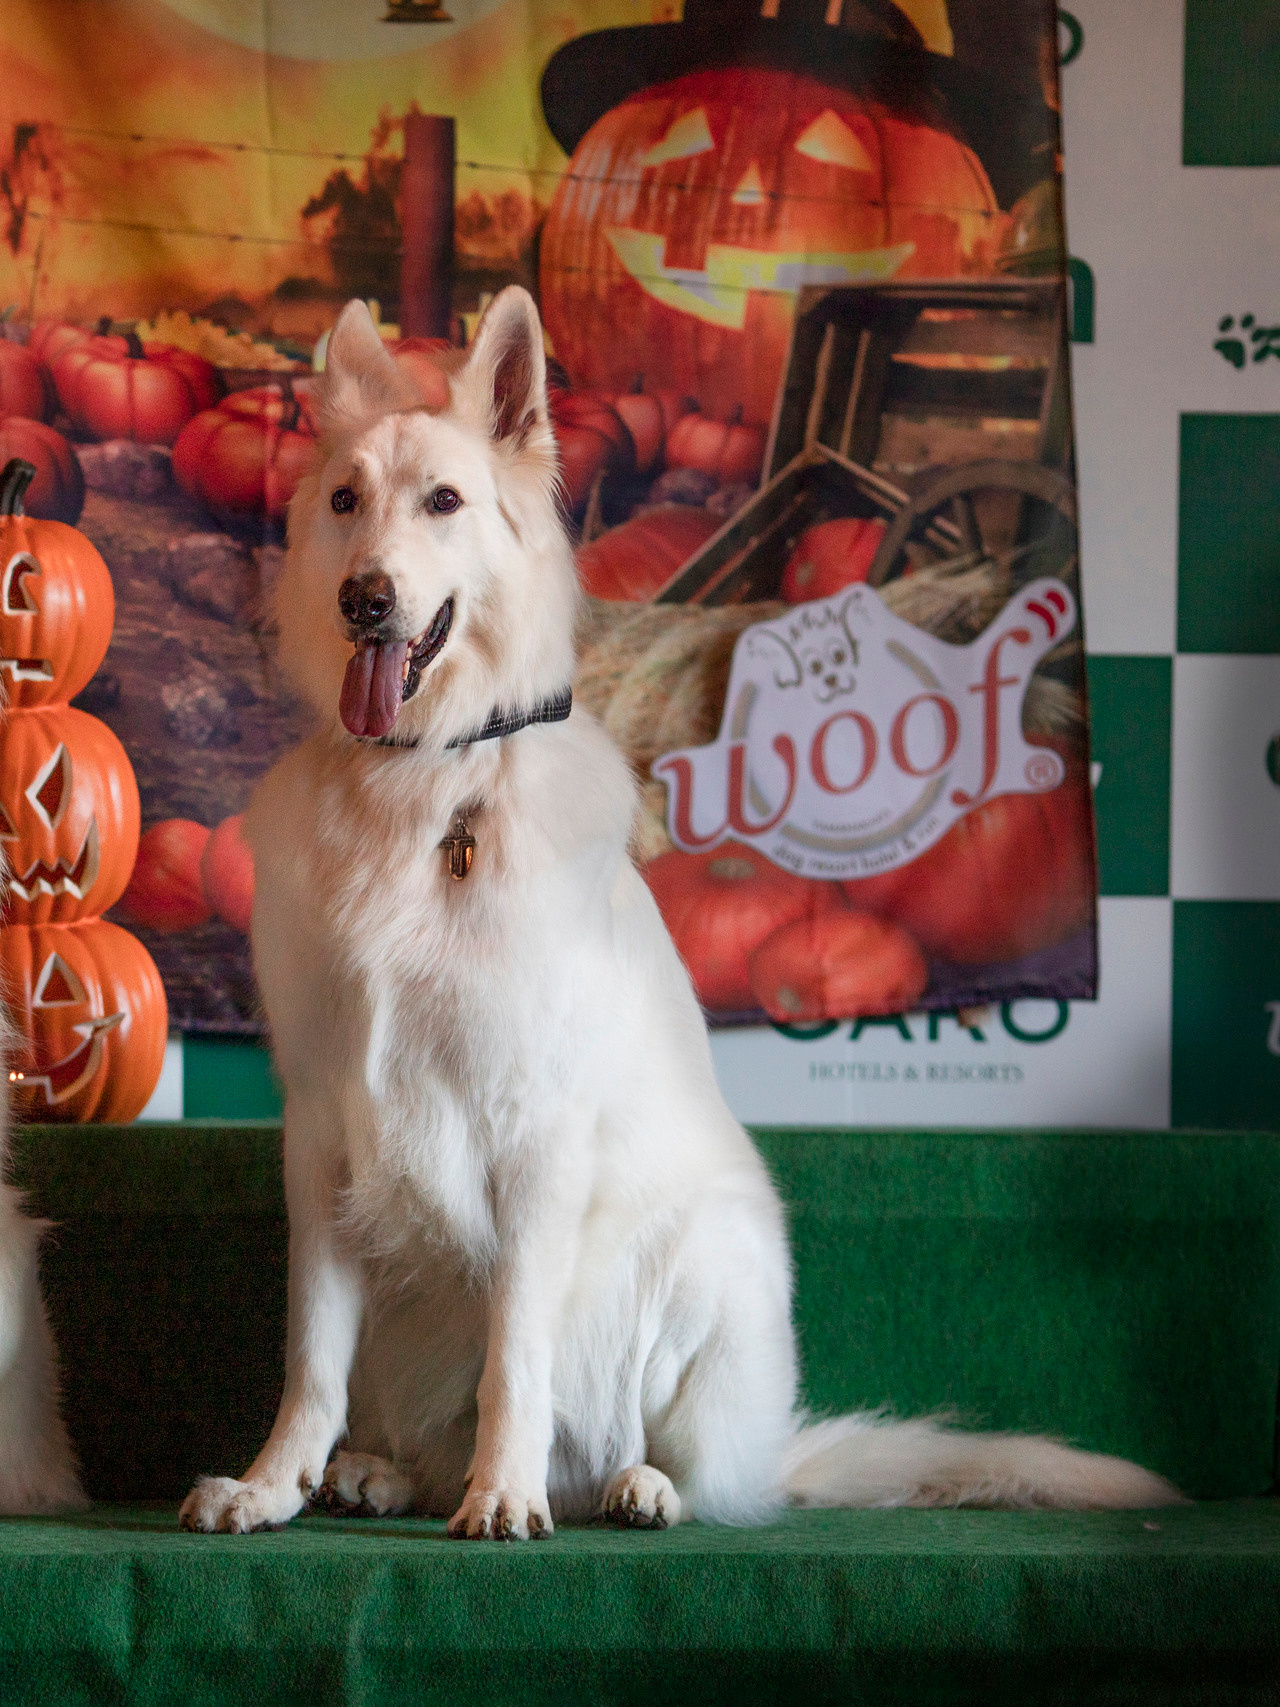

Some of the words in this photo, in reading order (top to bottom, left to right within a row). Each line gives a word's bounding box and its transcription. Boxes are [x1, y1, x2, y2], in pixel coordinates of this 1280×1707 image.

[658, 627, 1032, 854] woof
[808, 1061, 898, 1082] HOTELS
[903, 1062, 919, 1081] &
[926, 1061, 1025, 1083] RESORTS
